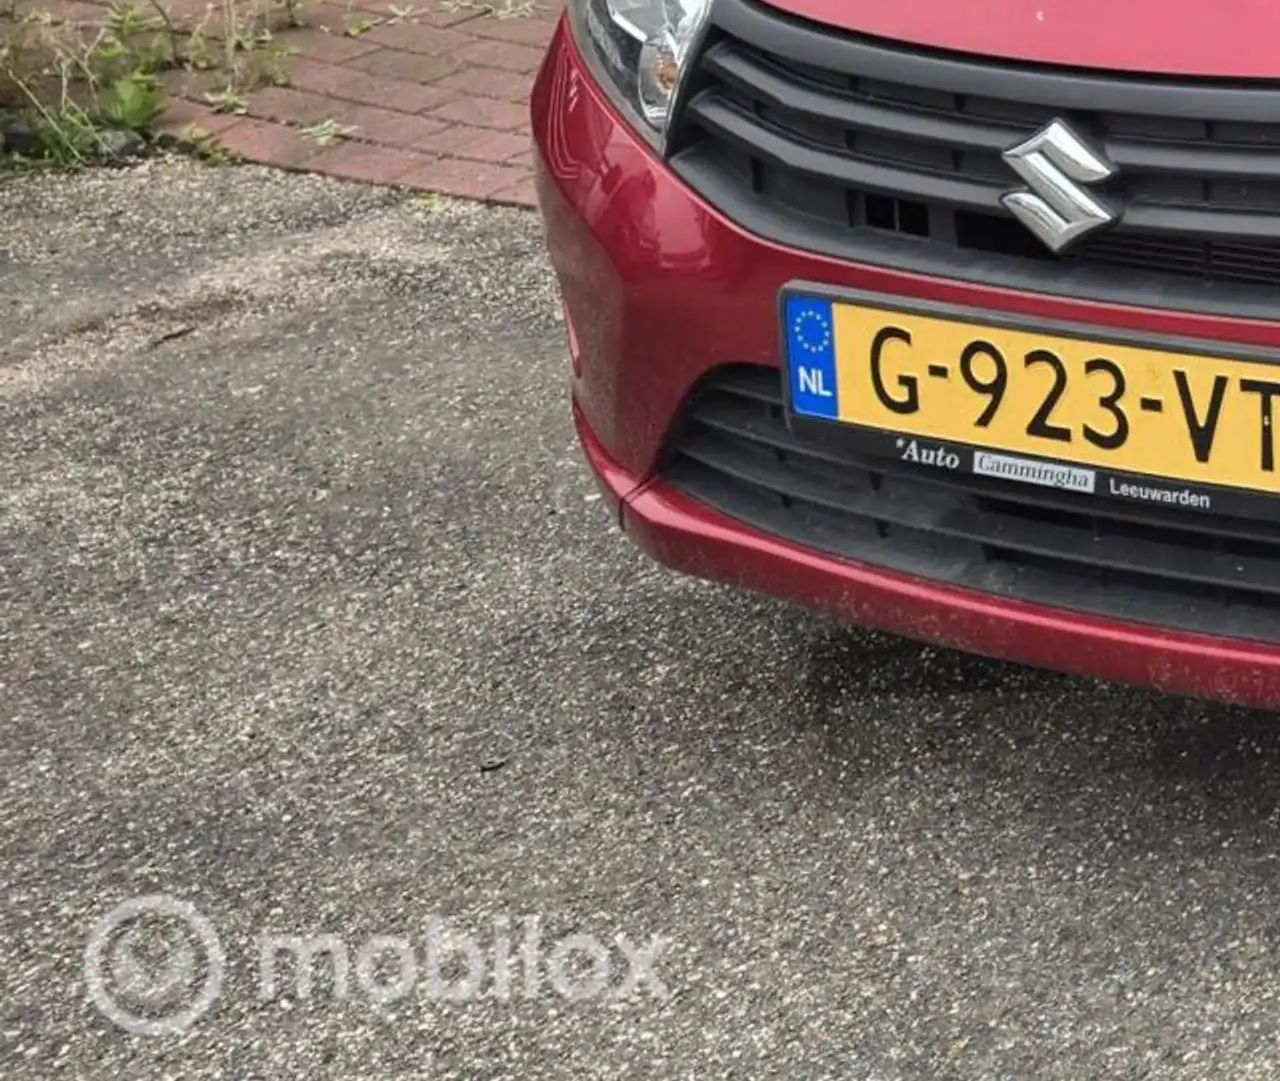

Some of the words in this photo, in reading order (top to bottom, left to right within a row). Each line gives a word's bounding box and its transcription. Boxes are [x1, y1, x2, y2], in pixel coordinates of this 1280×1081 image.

[799, 365, 833, 399] NL
[977, 452, 1091, 490] Cammingha
[1109, 477, 1211, 509] Leeuwarden
